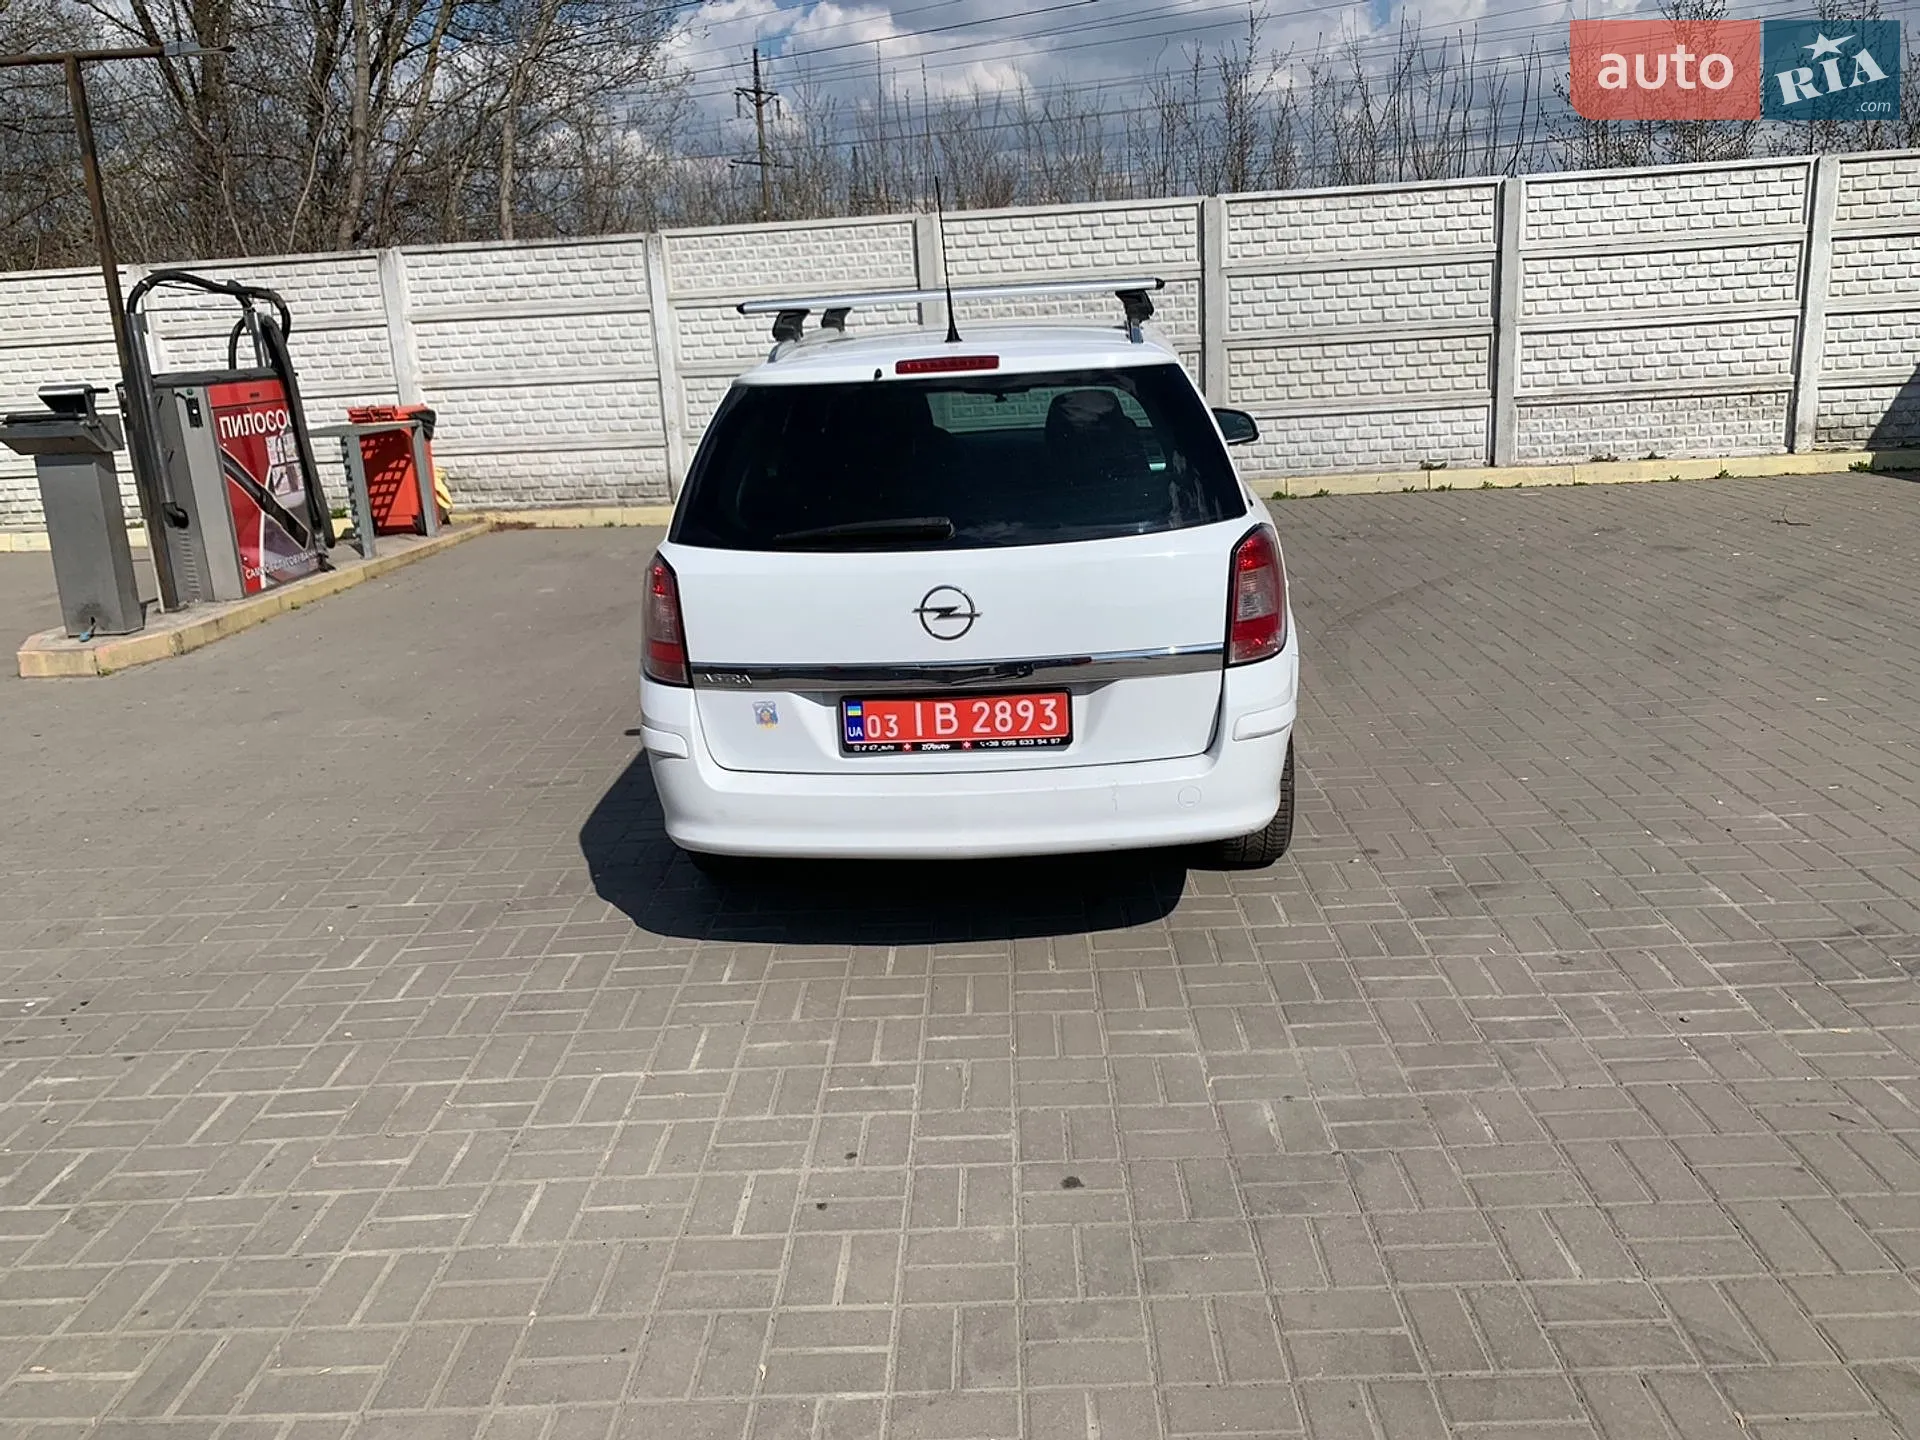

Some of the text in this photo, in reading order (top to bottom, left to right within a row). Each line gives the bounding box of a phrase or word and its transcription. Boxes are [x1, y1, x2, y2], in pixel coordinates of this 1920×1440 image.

[866, 698, 1058, 739] 03 IB 2893
[847, 726, 864, 738] UA
